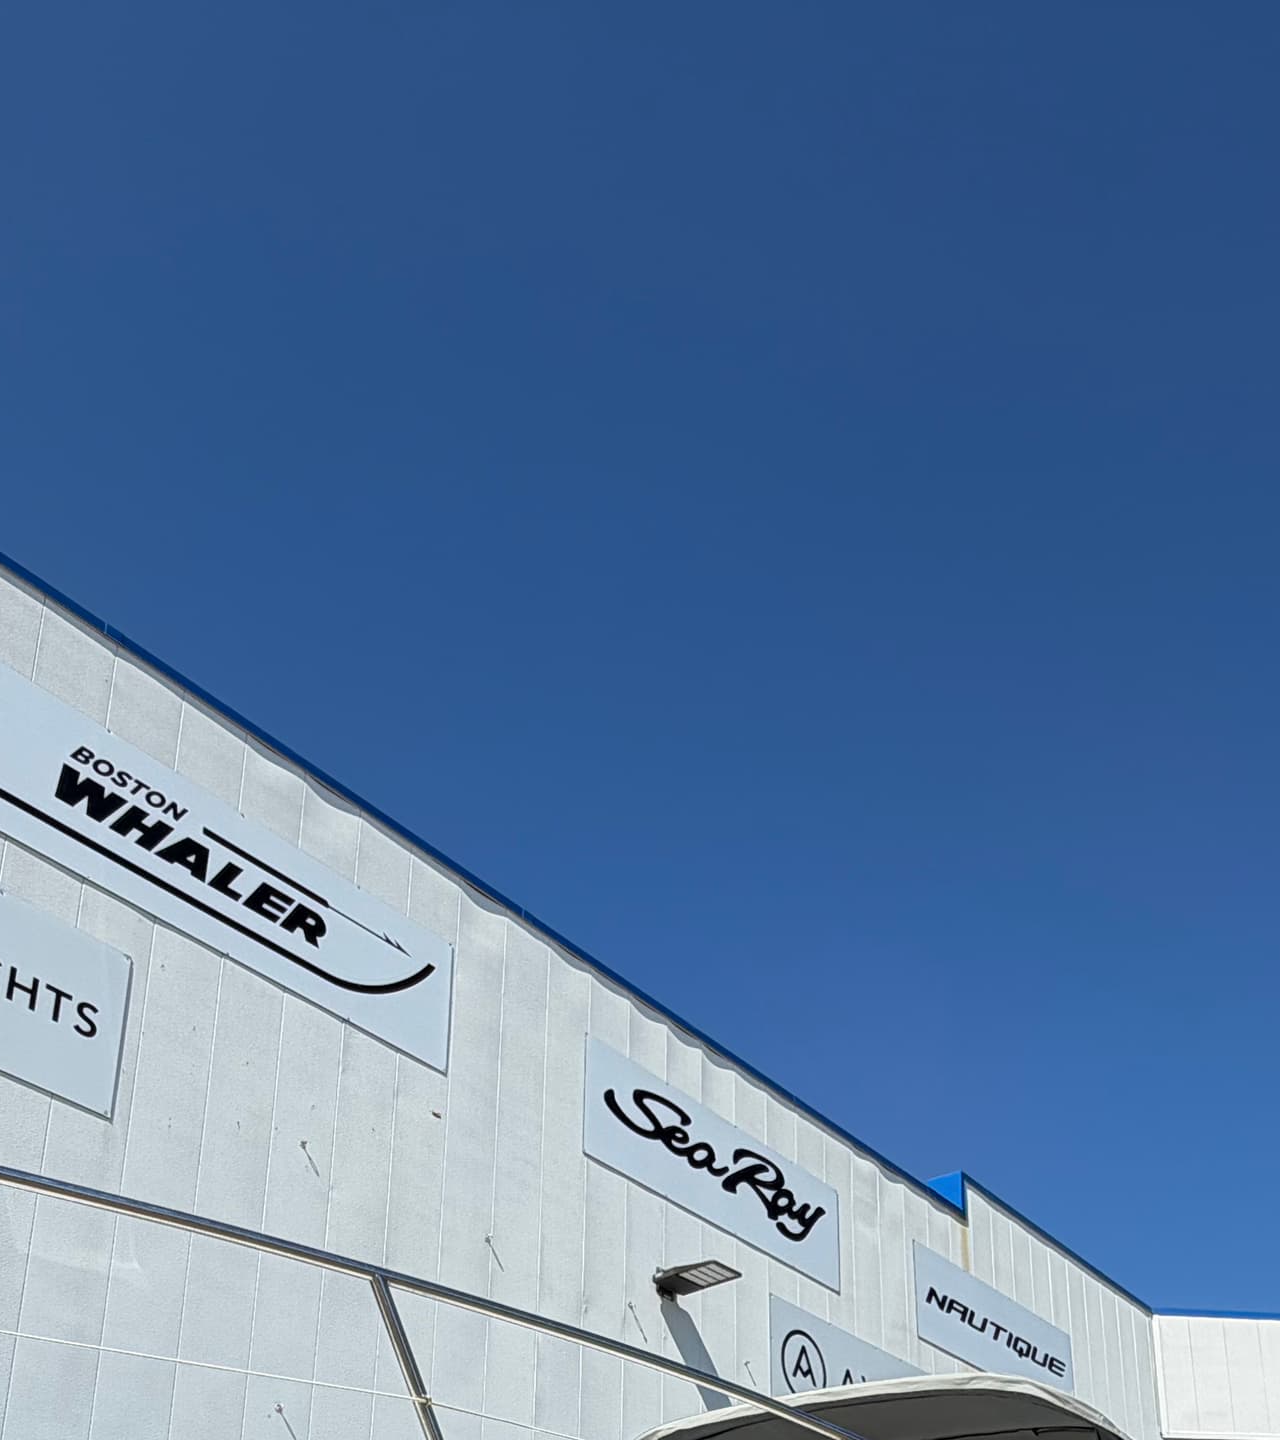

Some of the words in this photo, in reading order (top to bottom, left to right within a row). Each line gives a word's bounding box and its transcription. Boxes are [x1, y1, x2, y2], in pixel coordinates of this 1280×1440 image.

[70, 746, 189, 822] BOSTON
[54, 763, 328, 949] WHALER
[603, 1088, 729, 1178] Sea
[721, 1148, 827, 1242] Ray
[925, 1286, 1067, 1378] NAUTIQUE
